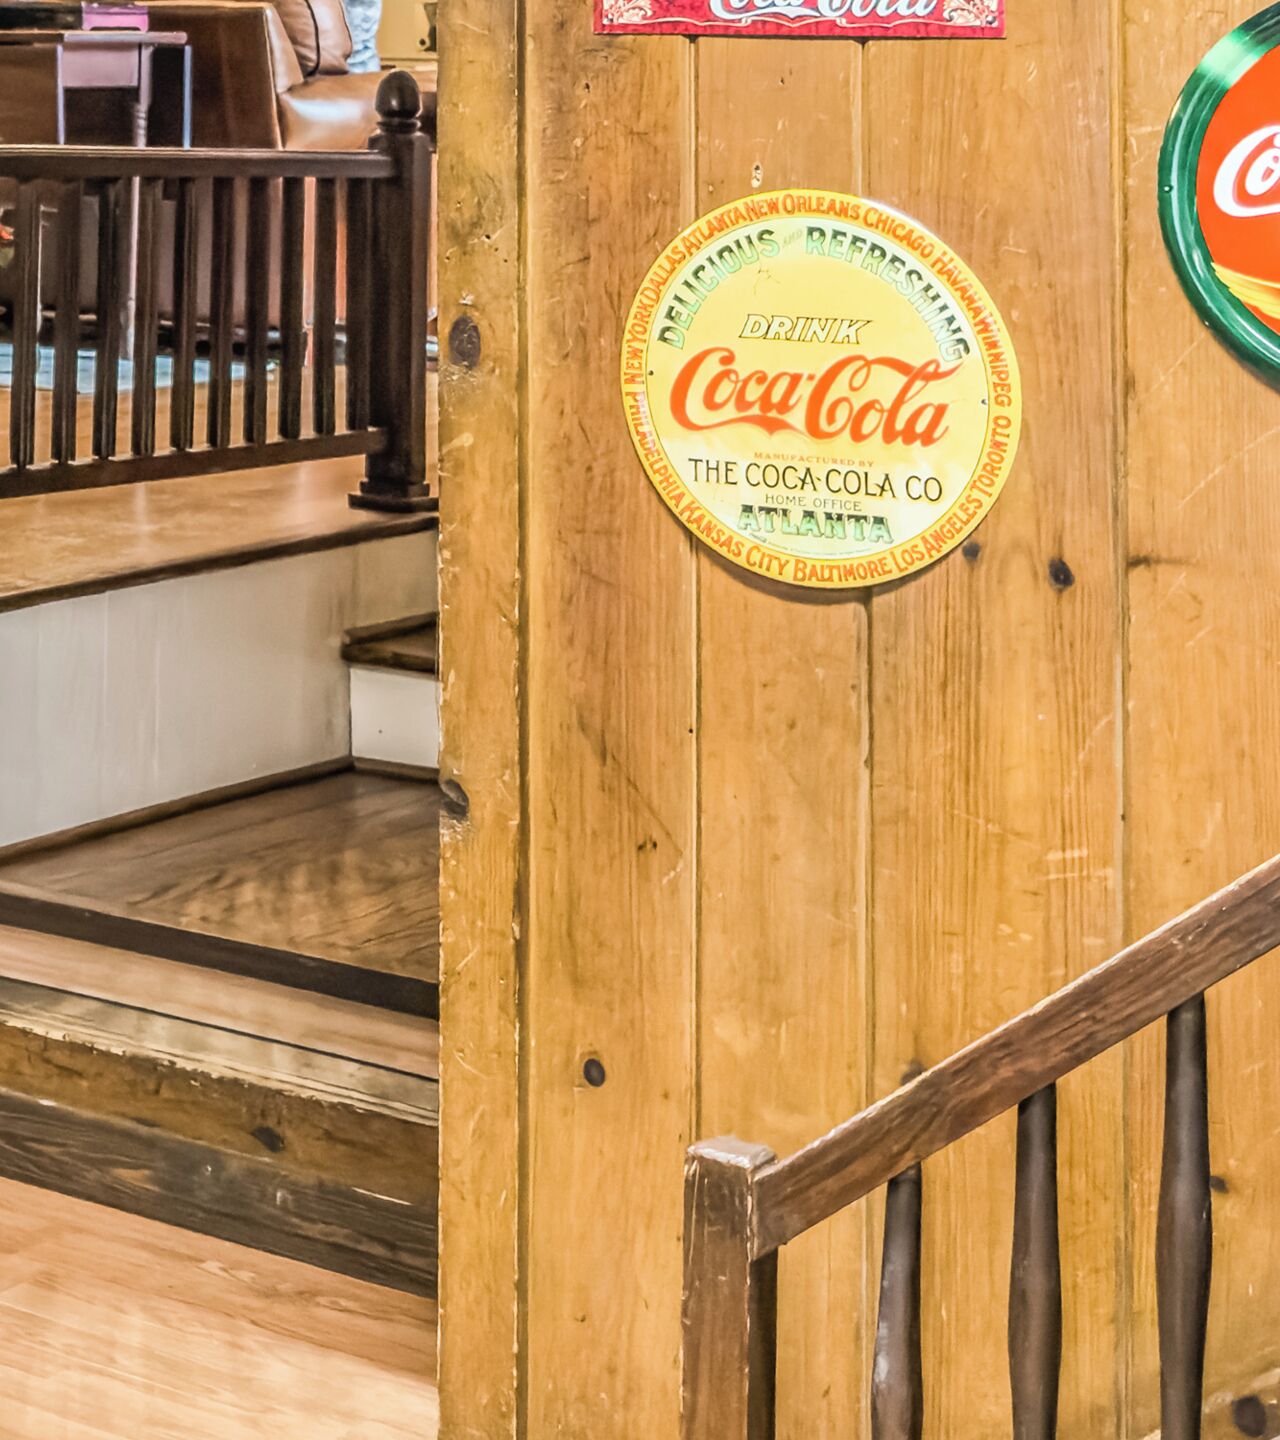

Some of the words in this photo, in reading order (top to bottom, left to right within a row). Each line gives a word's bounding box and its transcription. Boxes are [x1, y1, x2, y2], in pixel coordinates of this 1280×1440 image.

[744, 197, 781, 222] NEW
[781, 193, 861, 221] ORLEANS
[680, 205, 748, 257] ATLANTA
[862, 206, 935, 259] CHICAGO
[640, 245, 687, 306] DALLAS
[657, 228, 781, 350] DELICIOUS
[805, 225, 971, 363] REFRESHING
[931, 250, 986, 319] HAVANA
[627, 299, 655, 345] YORK
[738, 313, 873, 346] DRINK
[623, 345, 646, 386] NEW
[669, 346, 965, 448] Coca-Cola
[688, 458, 738, 486] THE
[905, 475, 943, 502] CO
[754, 452, 855, 467] MANUFACTURED
[858, 459, 875, 469] BY
[624, 391, 682, 509] PHILADELPHIA
[680, 498, 744, 558] KANSAS
[745, 544, 790, 577] CITY
[792, 557, 893, 584] BALTIMORE
[890, 544, 926, 574] LOS
[919, 492, 984, 560] ANGELES
[969, 415, 1012, 499] TORONTO
[765, 493, 807, 508] HOME
[813, 497, 863, 512] OFFICE
[737, 503, 895, 545] ATLANTA
